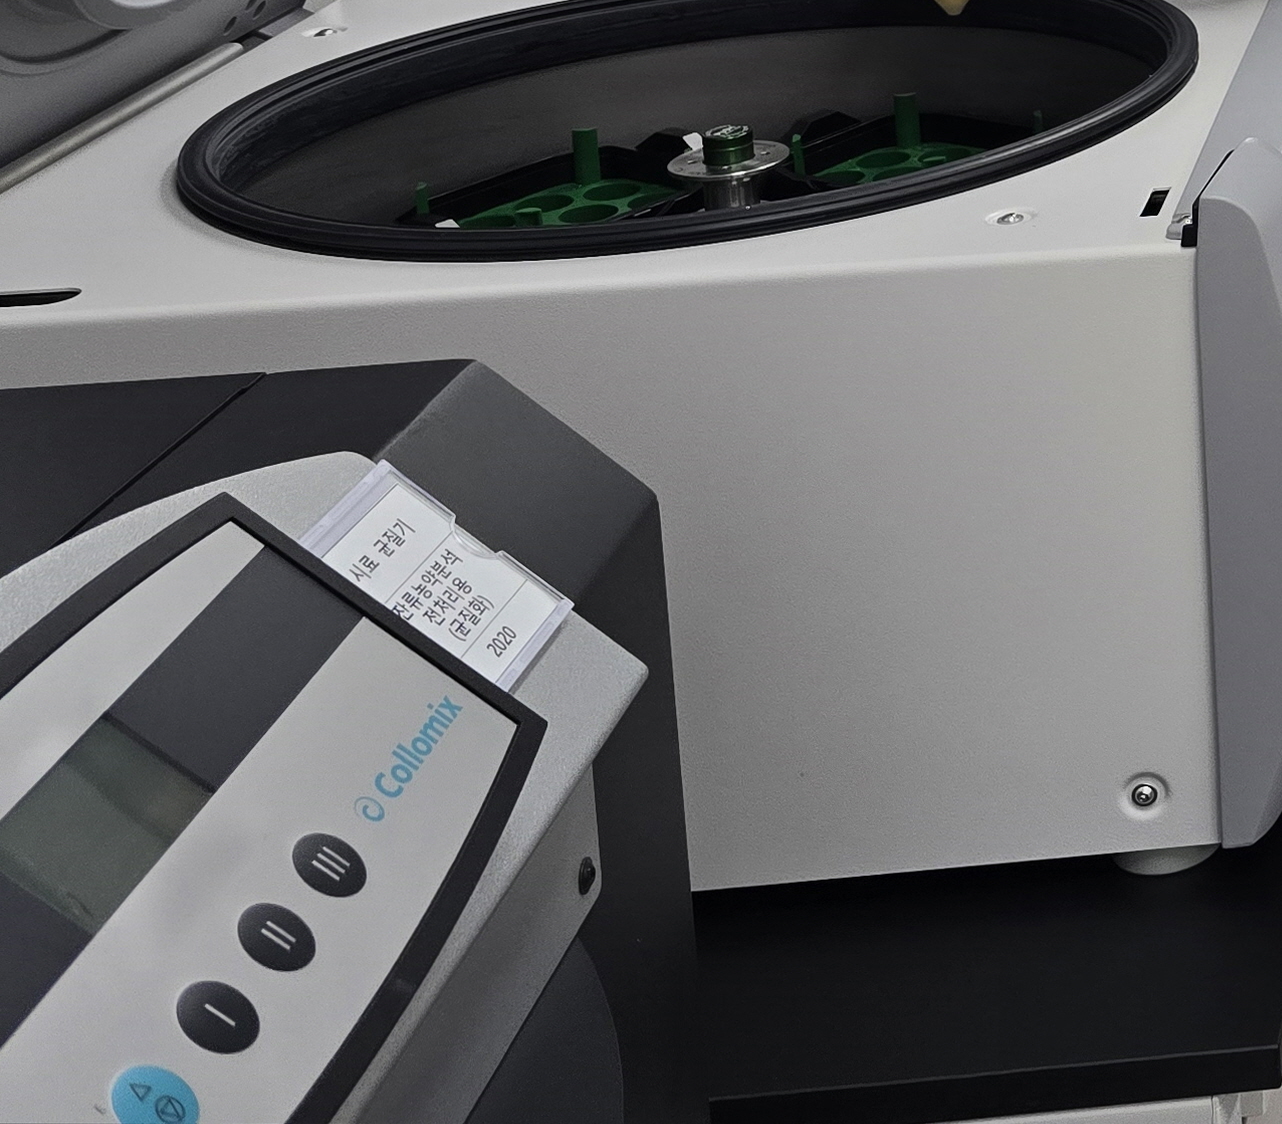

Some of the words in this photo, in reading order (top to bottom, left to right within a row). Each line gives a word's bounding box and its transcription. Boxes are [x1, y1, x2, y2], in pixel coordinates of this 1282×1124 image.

[349, 555, 380, 582] 시료
[373, 518, 416, 557] 균질기
[390, 549, 463, 621] 잔류농약분석
[423, 577, 472, 626] 전처리용
[449, 595, 495, 642] (균질화)
[486, 626, 517, 657] 2020
[374, 695, 463, 798] Collomix
